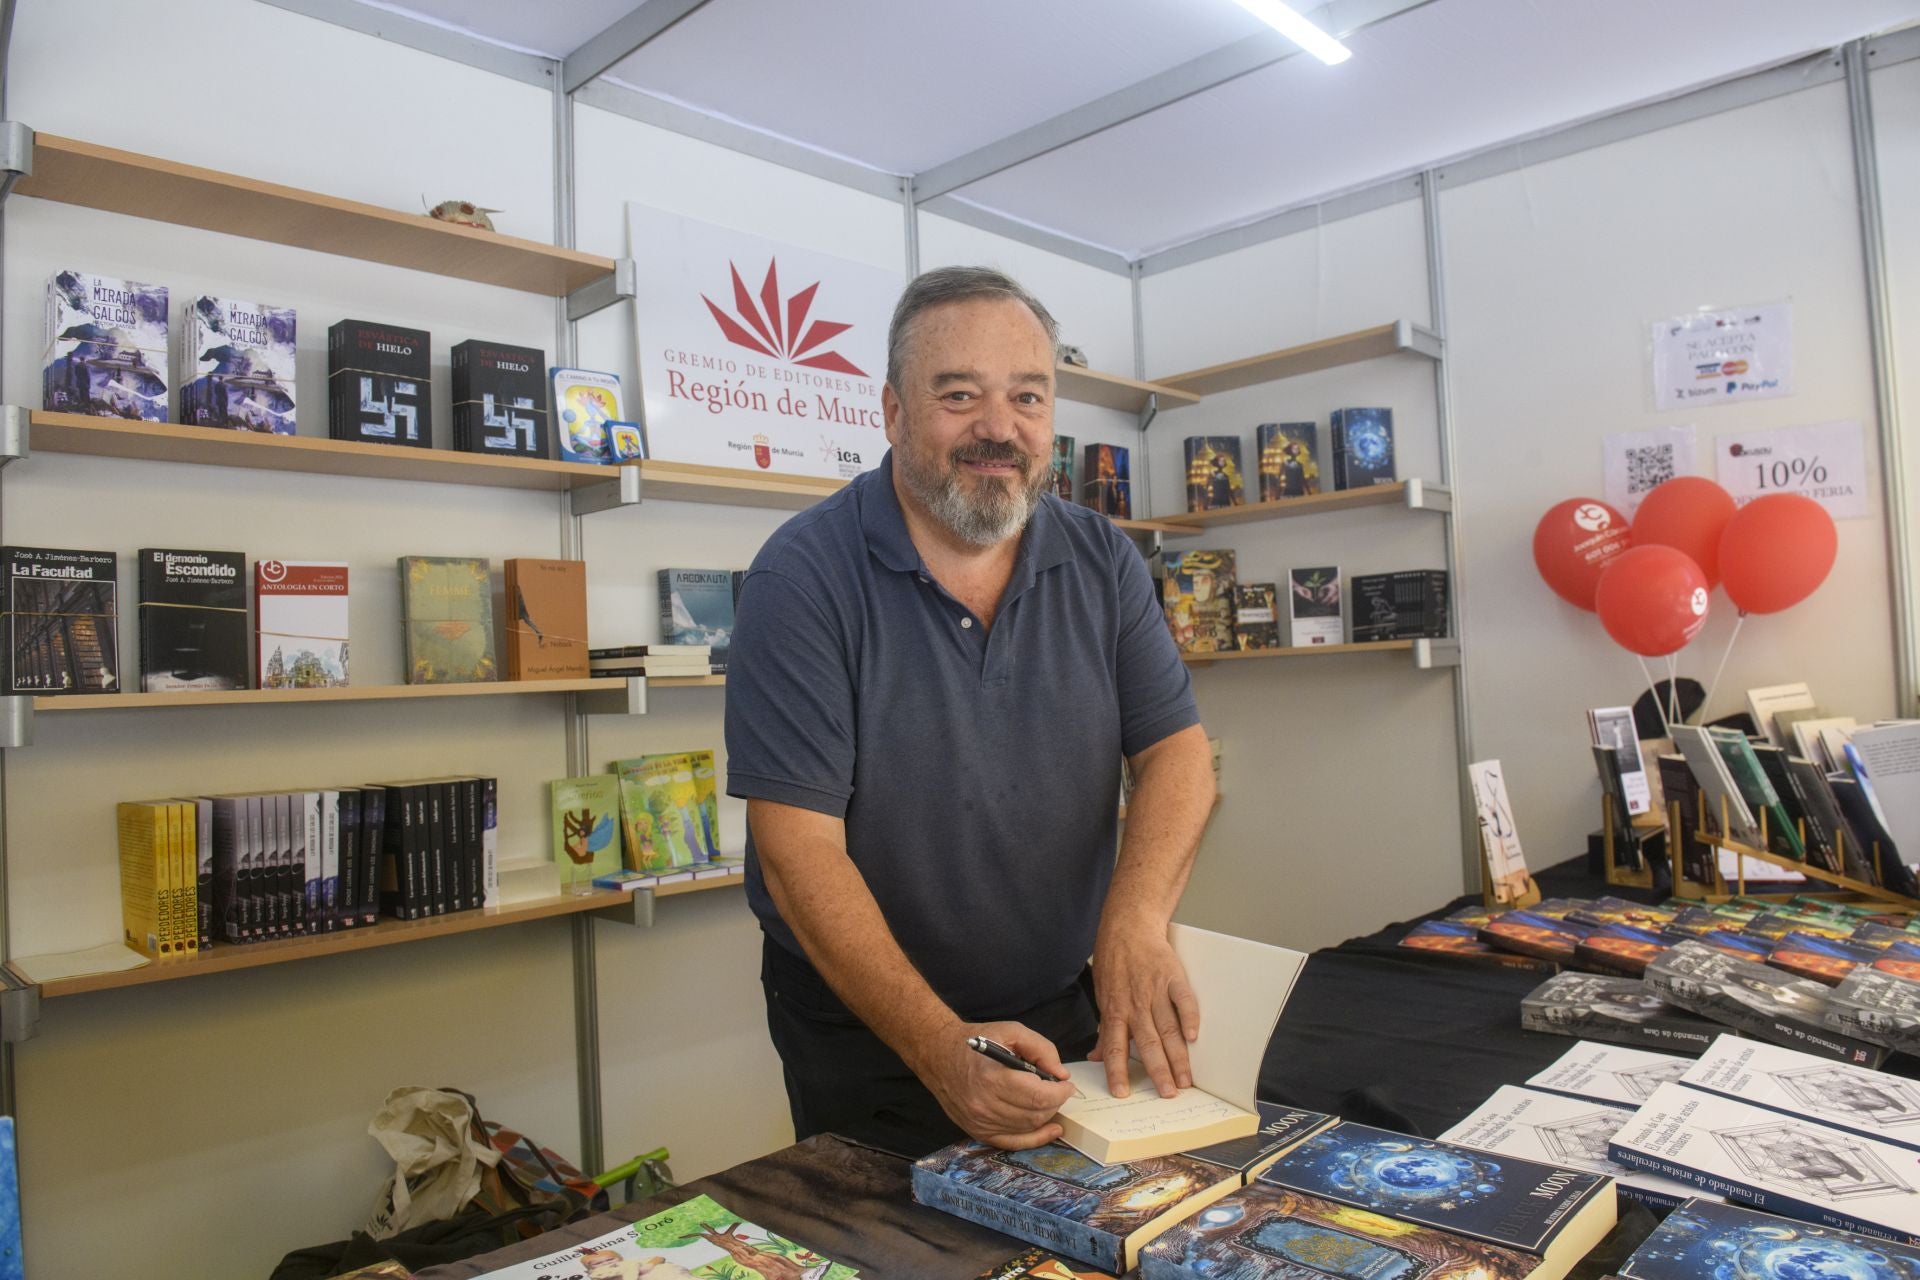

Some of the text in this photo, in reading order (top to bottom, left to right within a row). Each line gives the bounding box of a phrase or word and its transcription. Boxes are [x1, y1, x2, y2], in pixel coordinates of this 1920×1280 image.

[94, 287, 136, 306] MIRADA
[94, 306, 136, 324] GALGOS
[230, 311, 268, 329] MIRADA
[230, 328, 268, 346] GALGOS
[376, 342, 412, 356] HIELO
[496, 361, 529, 372] HIELO
[664, 348, 876, 396] GREMIO DE EDITORES DE
[1742, 379, 1778, 391] PayPal
[666, 369, 882, 428] Región de Murc
[728, 441, 752, 452] Región
[782, 448, 804, 458] Murcia
[838, 448, 862, 464] ica
[1756, 455, 1828, 489] 10%
[1813, 486, 1854, 498] FERIA
[14, 551, 32, 560] José
[154, 552, 208, 564] El demonio
[12, 562, 93, 578] La Facultad
[166, 562, 236, 577] Escondido
[676, 573, 728, 584] ARGONAUTA
[158, 890, 170, 942] PERDEDORES
[172, 888, 184, 940] PERDEDORES
[184, 886, 196, 938] PERDEDORES
[1662, 1030, 1671, 1038] da
[1673, 1030, 1709, 1043] Fernando
[1775, 1022, 1846, 1054] Fernando da Casa
[1258, 1112, 1309, 1136] MOON
[1654, 1123, 1680, 1146] cuadrado
[1680, 1100, 1700, 1117] aristas
[1664, 1132, 1693, 1156] circulares
[1530, 1170, 1578, 1200] MOON
[1617, 1150, 1766, 1205] El cuadrado de aristas circulares
[1634, 1192, 1644, 1200] da
[1002, 1216, 1017, 1228] LOS
[1494, 1199, 1546, 1237] BLACK
[1823, 1214, 1842, 1228] Casa
[1844, 1220, 1855, 1231] da
[626, 1230, 644, 1238] S.
[644, 1216, 674, 1231] Oró
[1020, 1223, 1030, 1232] DE
[1034, 1226, 1062, 1242] NOCHE
[1066, 1238, 1077, 1250] LA
